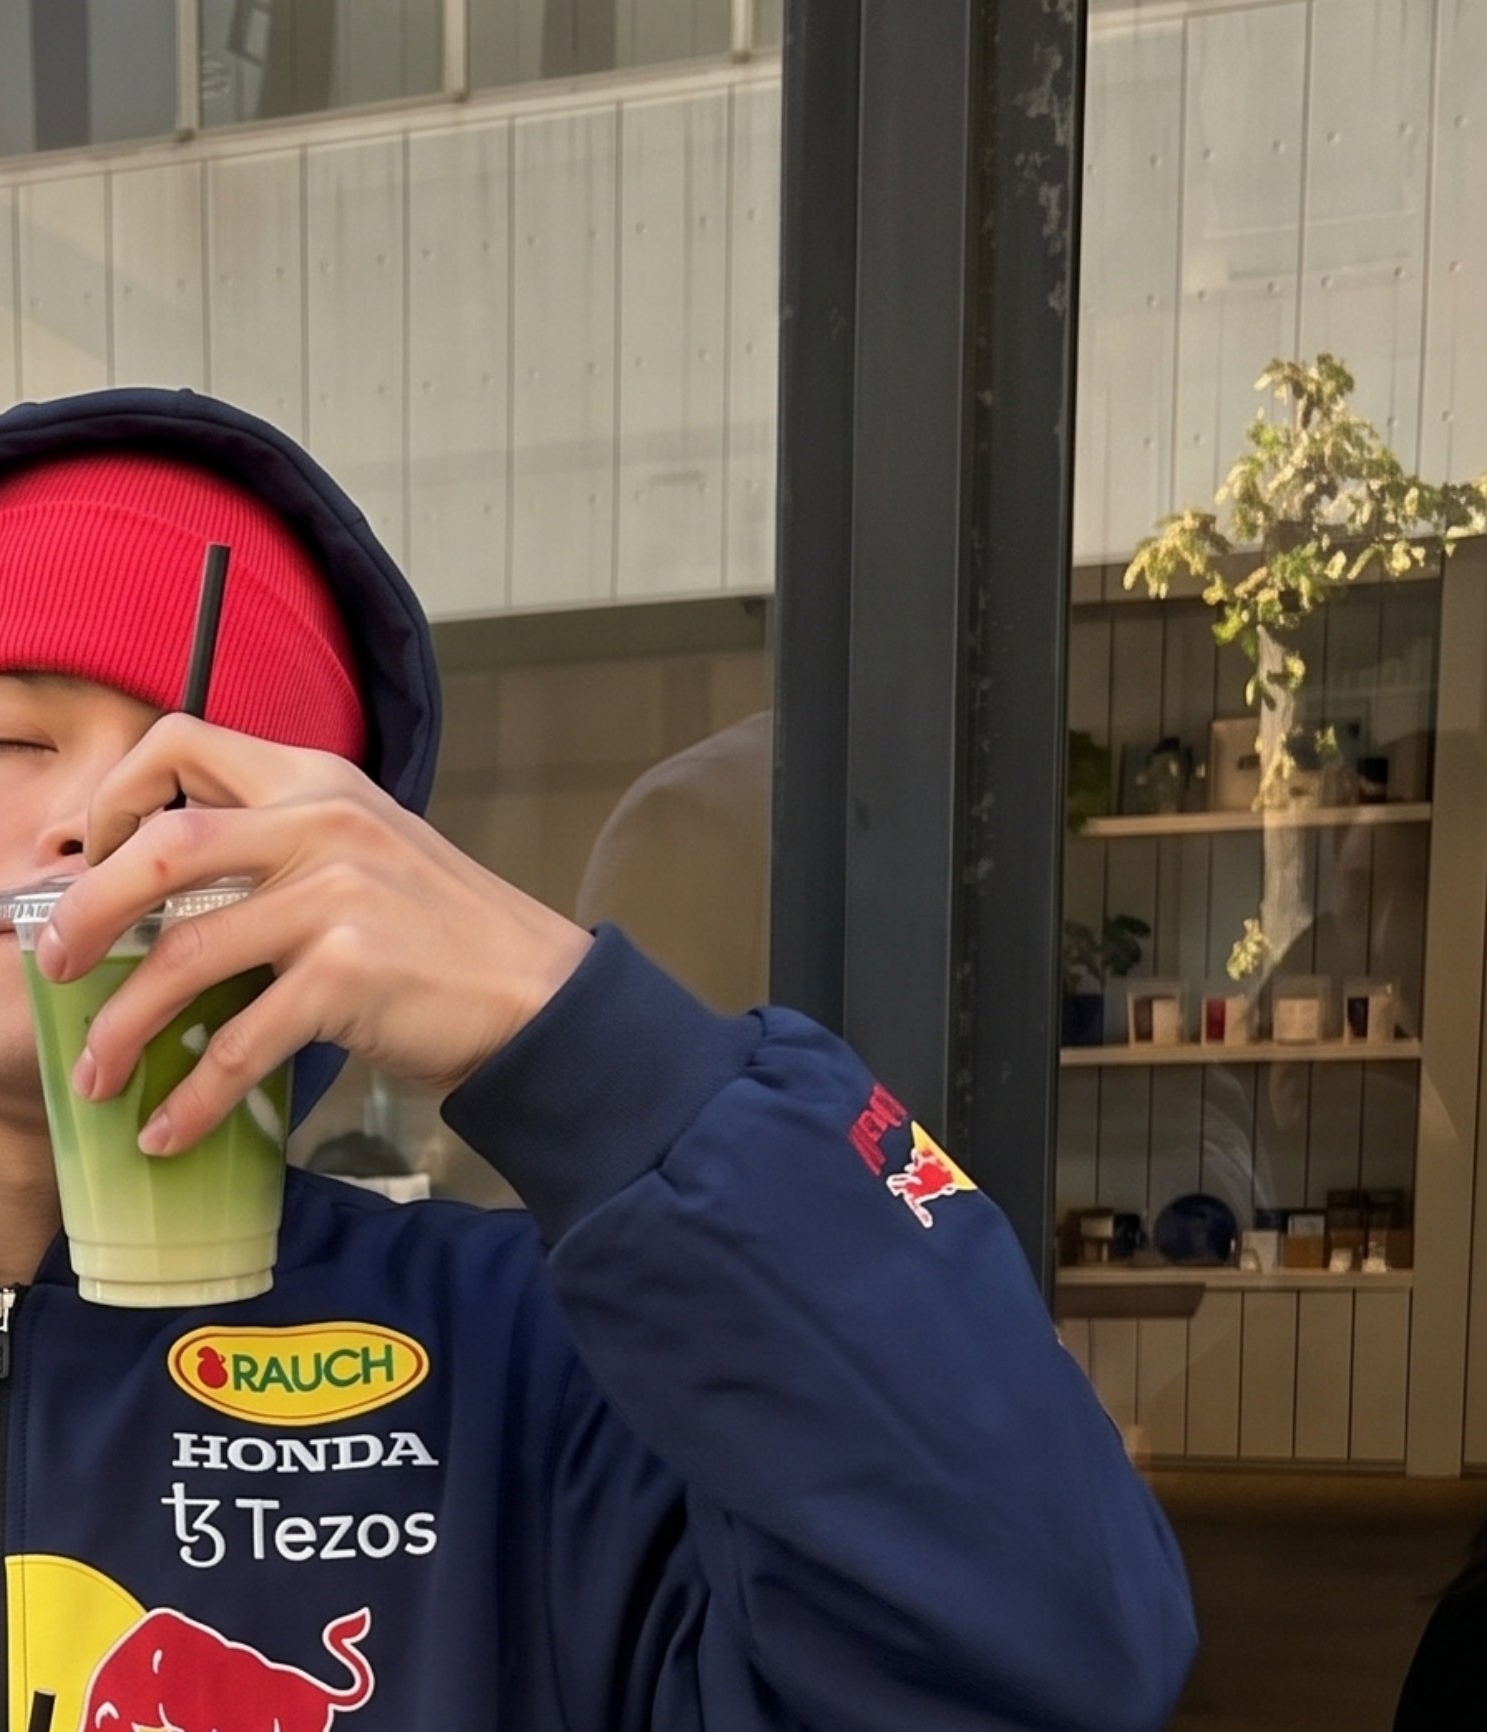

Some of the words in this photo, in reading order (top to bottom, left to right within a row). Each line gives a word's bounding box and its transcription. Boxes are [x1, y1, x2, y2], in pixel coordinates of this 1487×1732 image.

[232, 1343, 395, 1394] RAUCH
[171, 1431, 440, 1474] HONDA
[234, 1498, 438, 1562] Tezos
